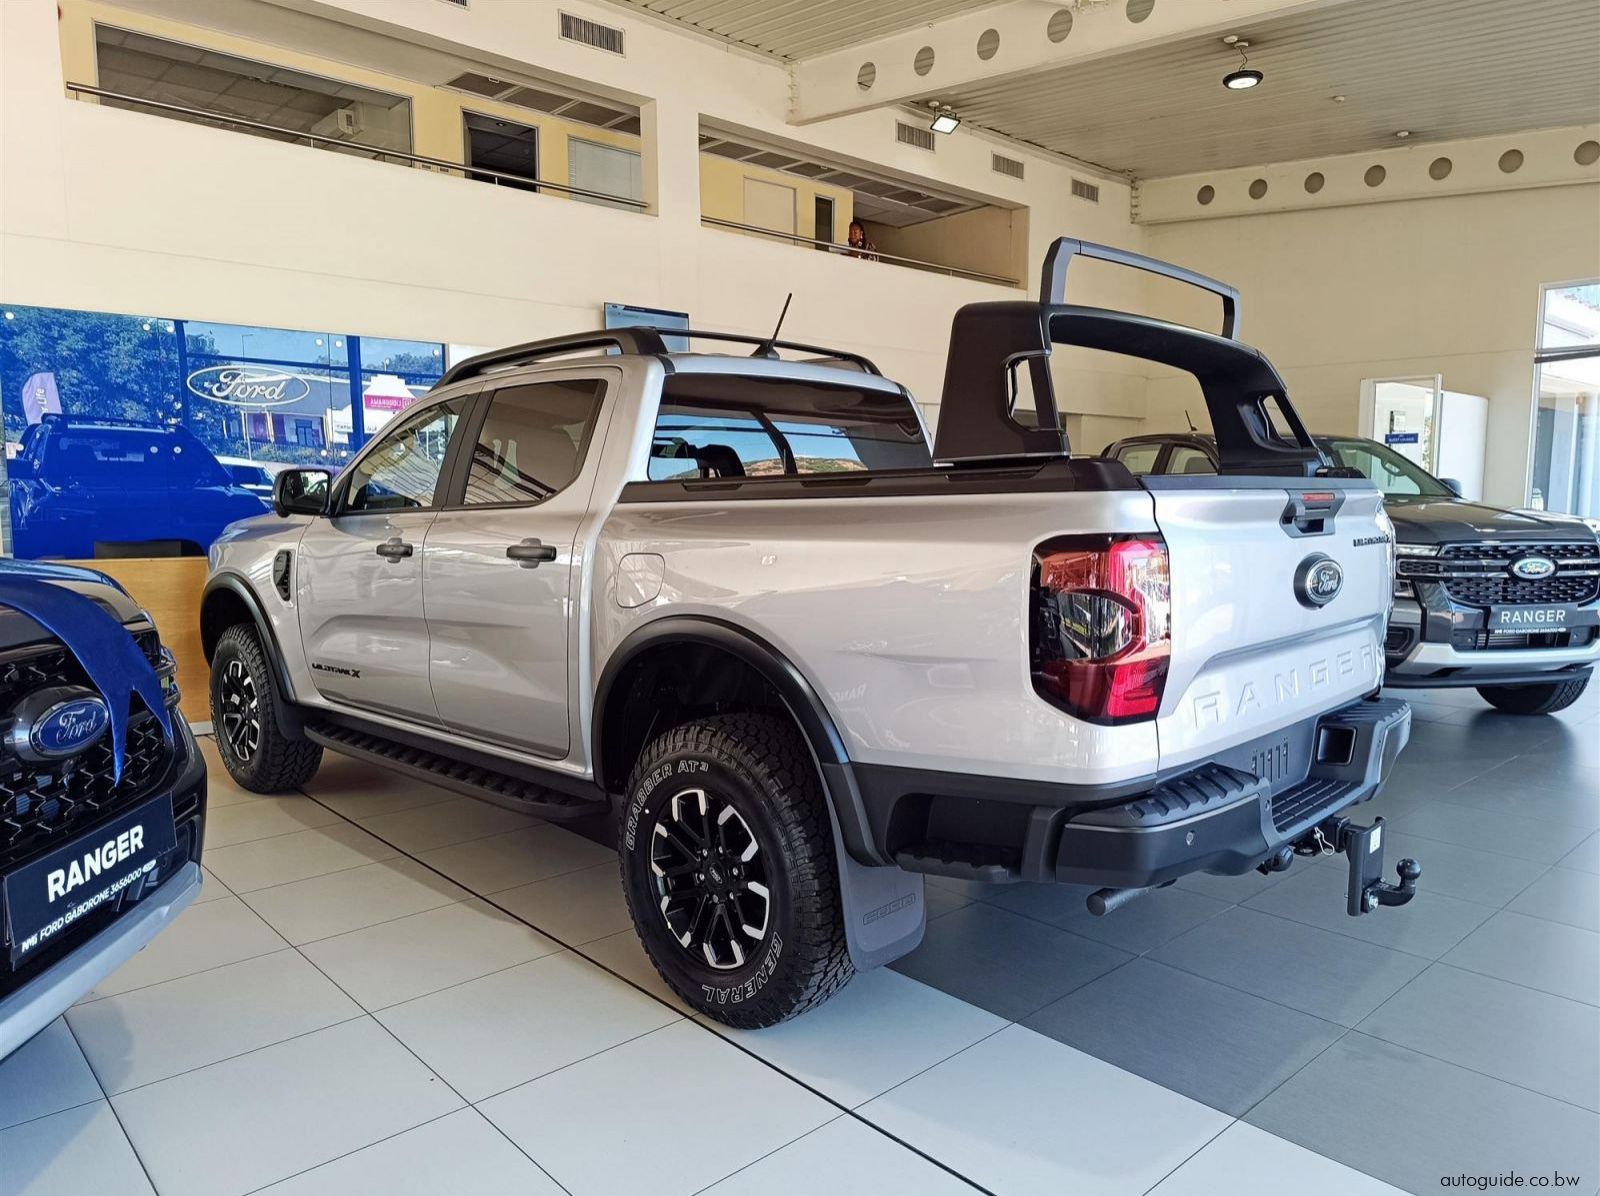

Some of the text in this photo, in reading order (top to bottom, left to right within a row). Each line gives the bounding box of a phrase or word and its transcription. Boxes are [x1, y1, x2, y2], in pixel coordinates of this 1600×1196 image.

[212, 370, 286, 400] Ford
[1319, 569, 1338, 593] Ford
[1501, 609, 1566, 624] RANGER
[1193, 643, 1376, 728] RANGER
[56, 707, 97, 744] Ford
[626, 763, 673, 851] GRABBER
[47, 825, 145, 903] RANGER
[40, 917, 64, 941] FORD
[65, 888, 110, 924] GABORONE
[110, 867, 142, 893] 3656000
[702, 931, 783, 1004] GENERAL
